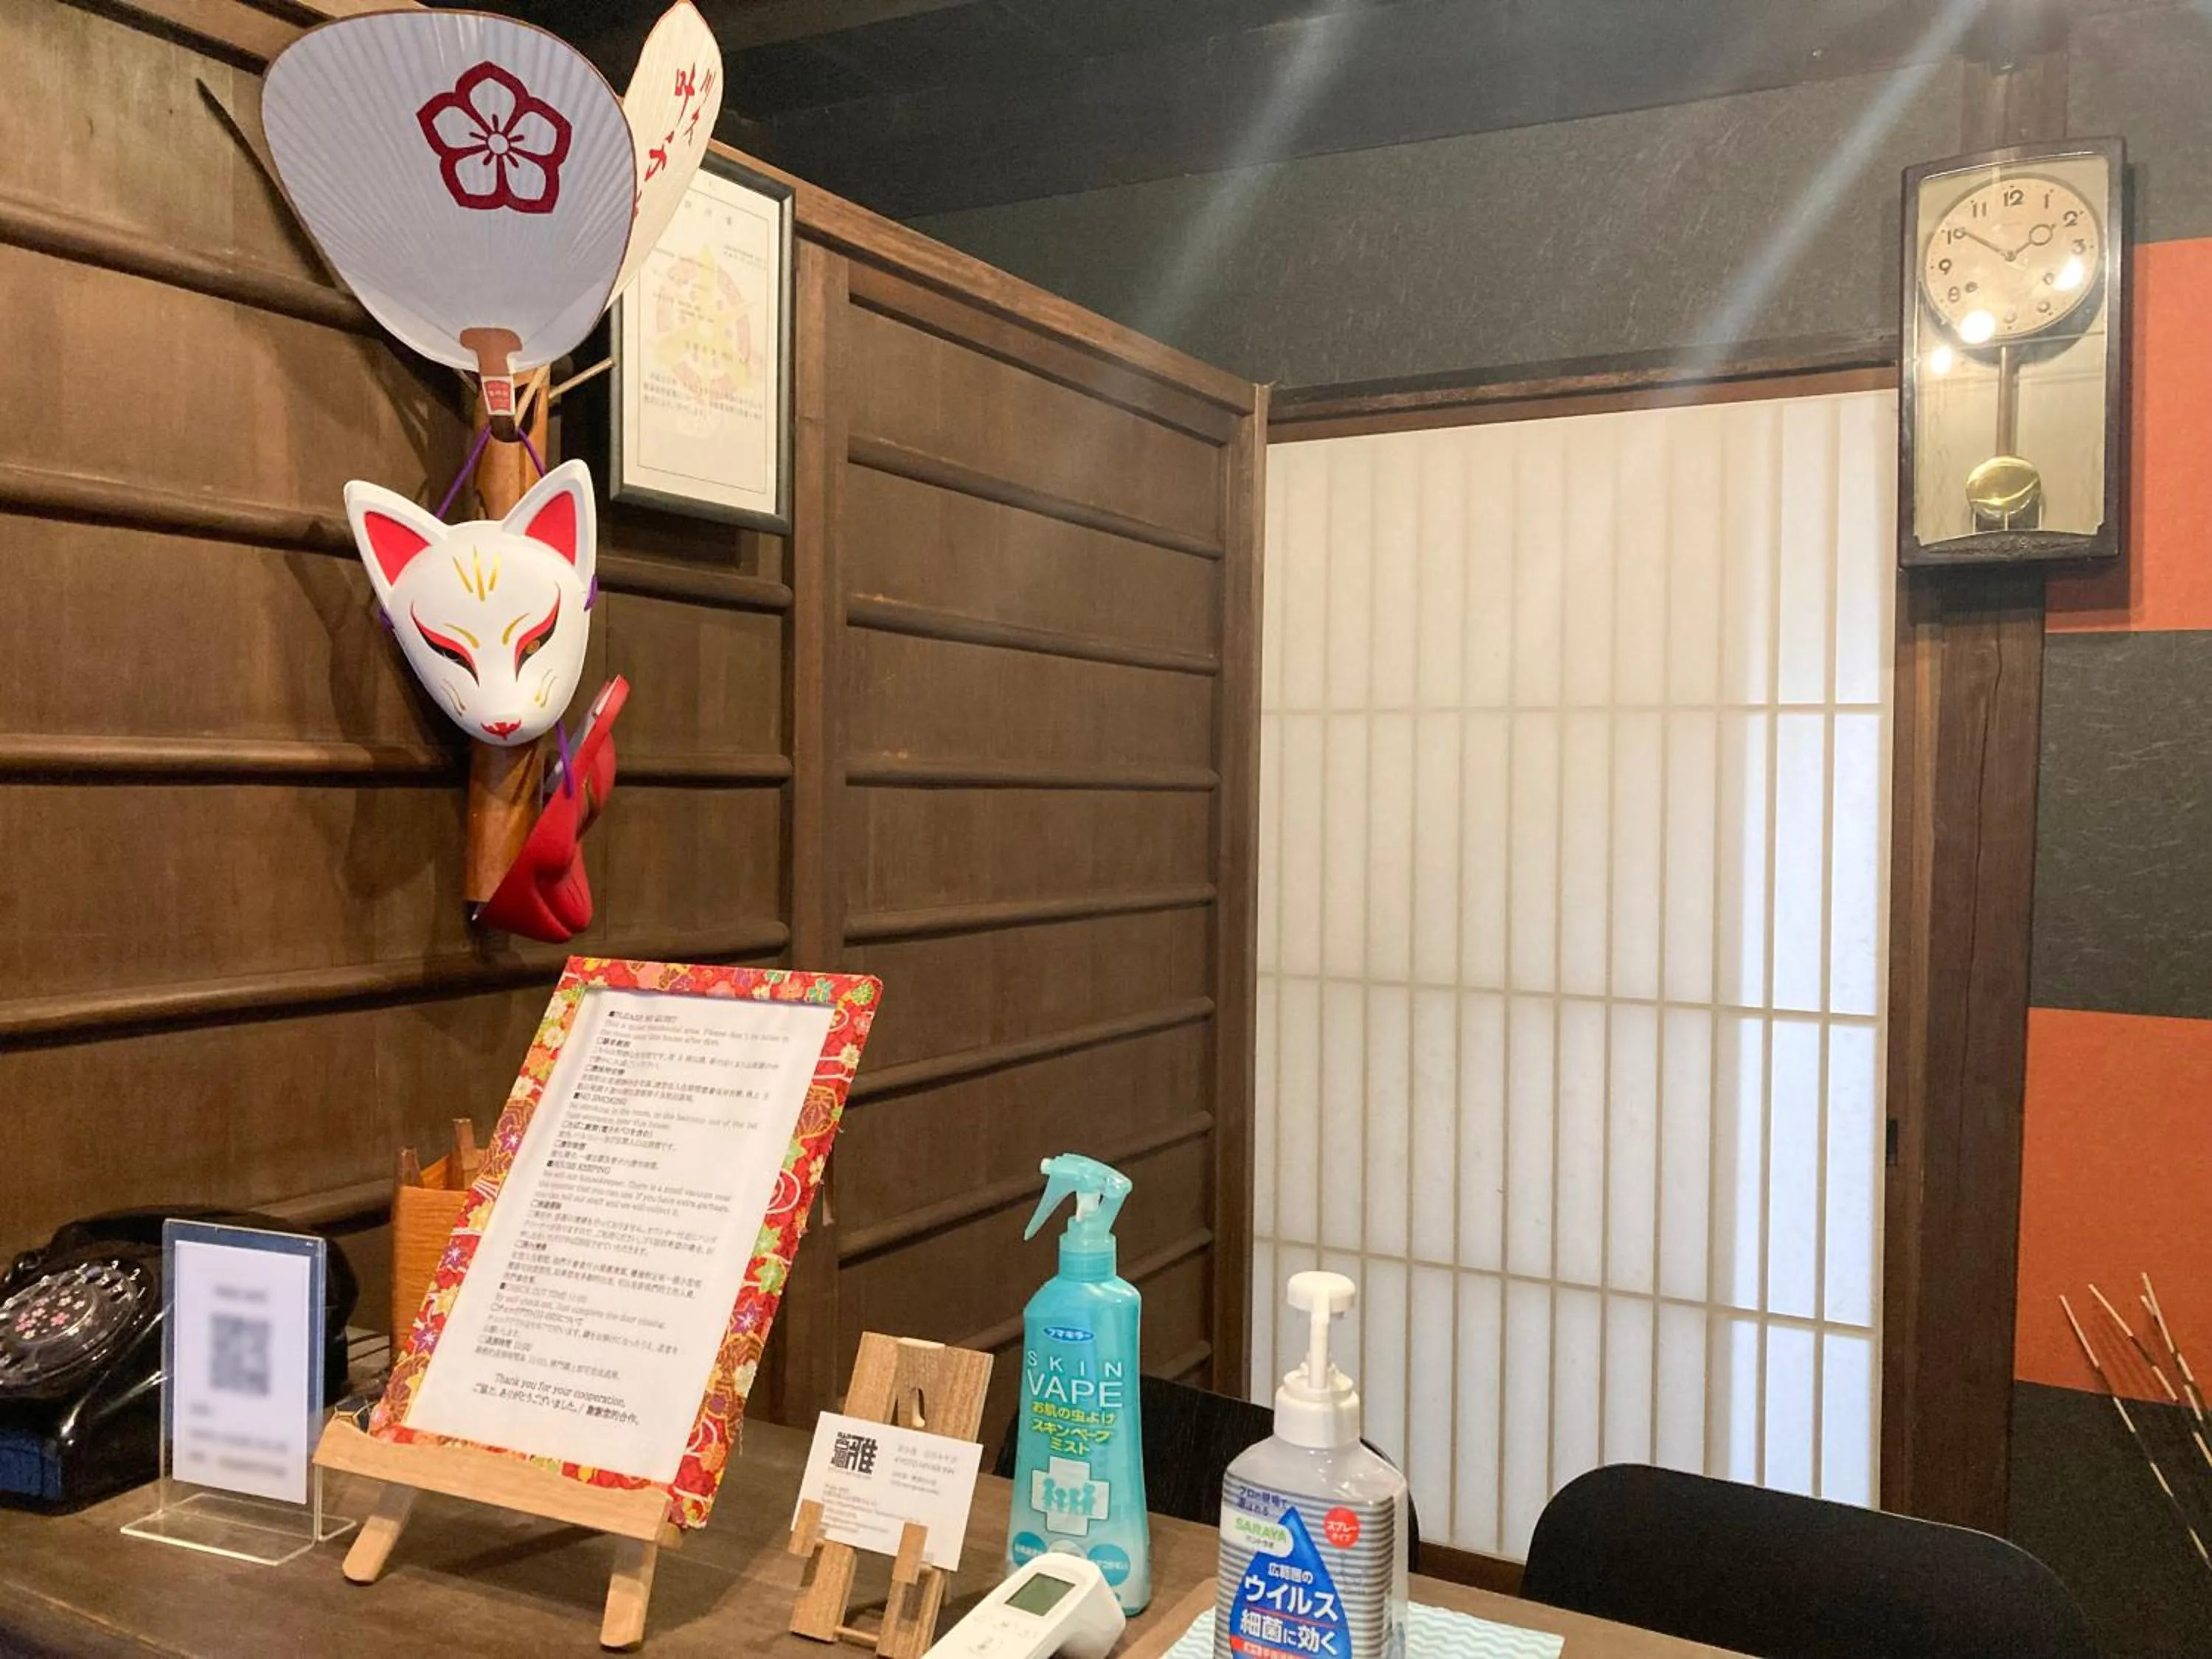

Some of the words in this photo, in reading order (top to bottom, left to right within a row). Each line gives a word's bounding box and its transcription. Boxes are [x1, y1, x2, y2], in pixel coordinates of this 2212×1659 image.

[2003, 189, 2024, 206] 12
[2044, 193, 2049, 209] 1
[1972, 201, 1986, 218] 11
[2064, 210, 2078, 227] 2
[1938, 259, 1952, 275] 9
[1028, 1350, 1122, 1378] SKIN
[1027, 1369, 1123, 1408] VAPE
[1032, 1401, 1116, 1425] お肌の虫よけ
[1050, 1436, 1091, 1455] ミスト
[1234, 1517, 1287, 1543] SARAYA
[1245, 1574, 1338, 1621] ウイルス
[1239, 1608, 1338, 1656] 細菌に効く
